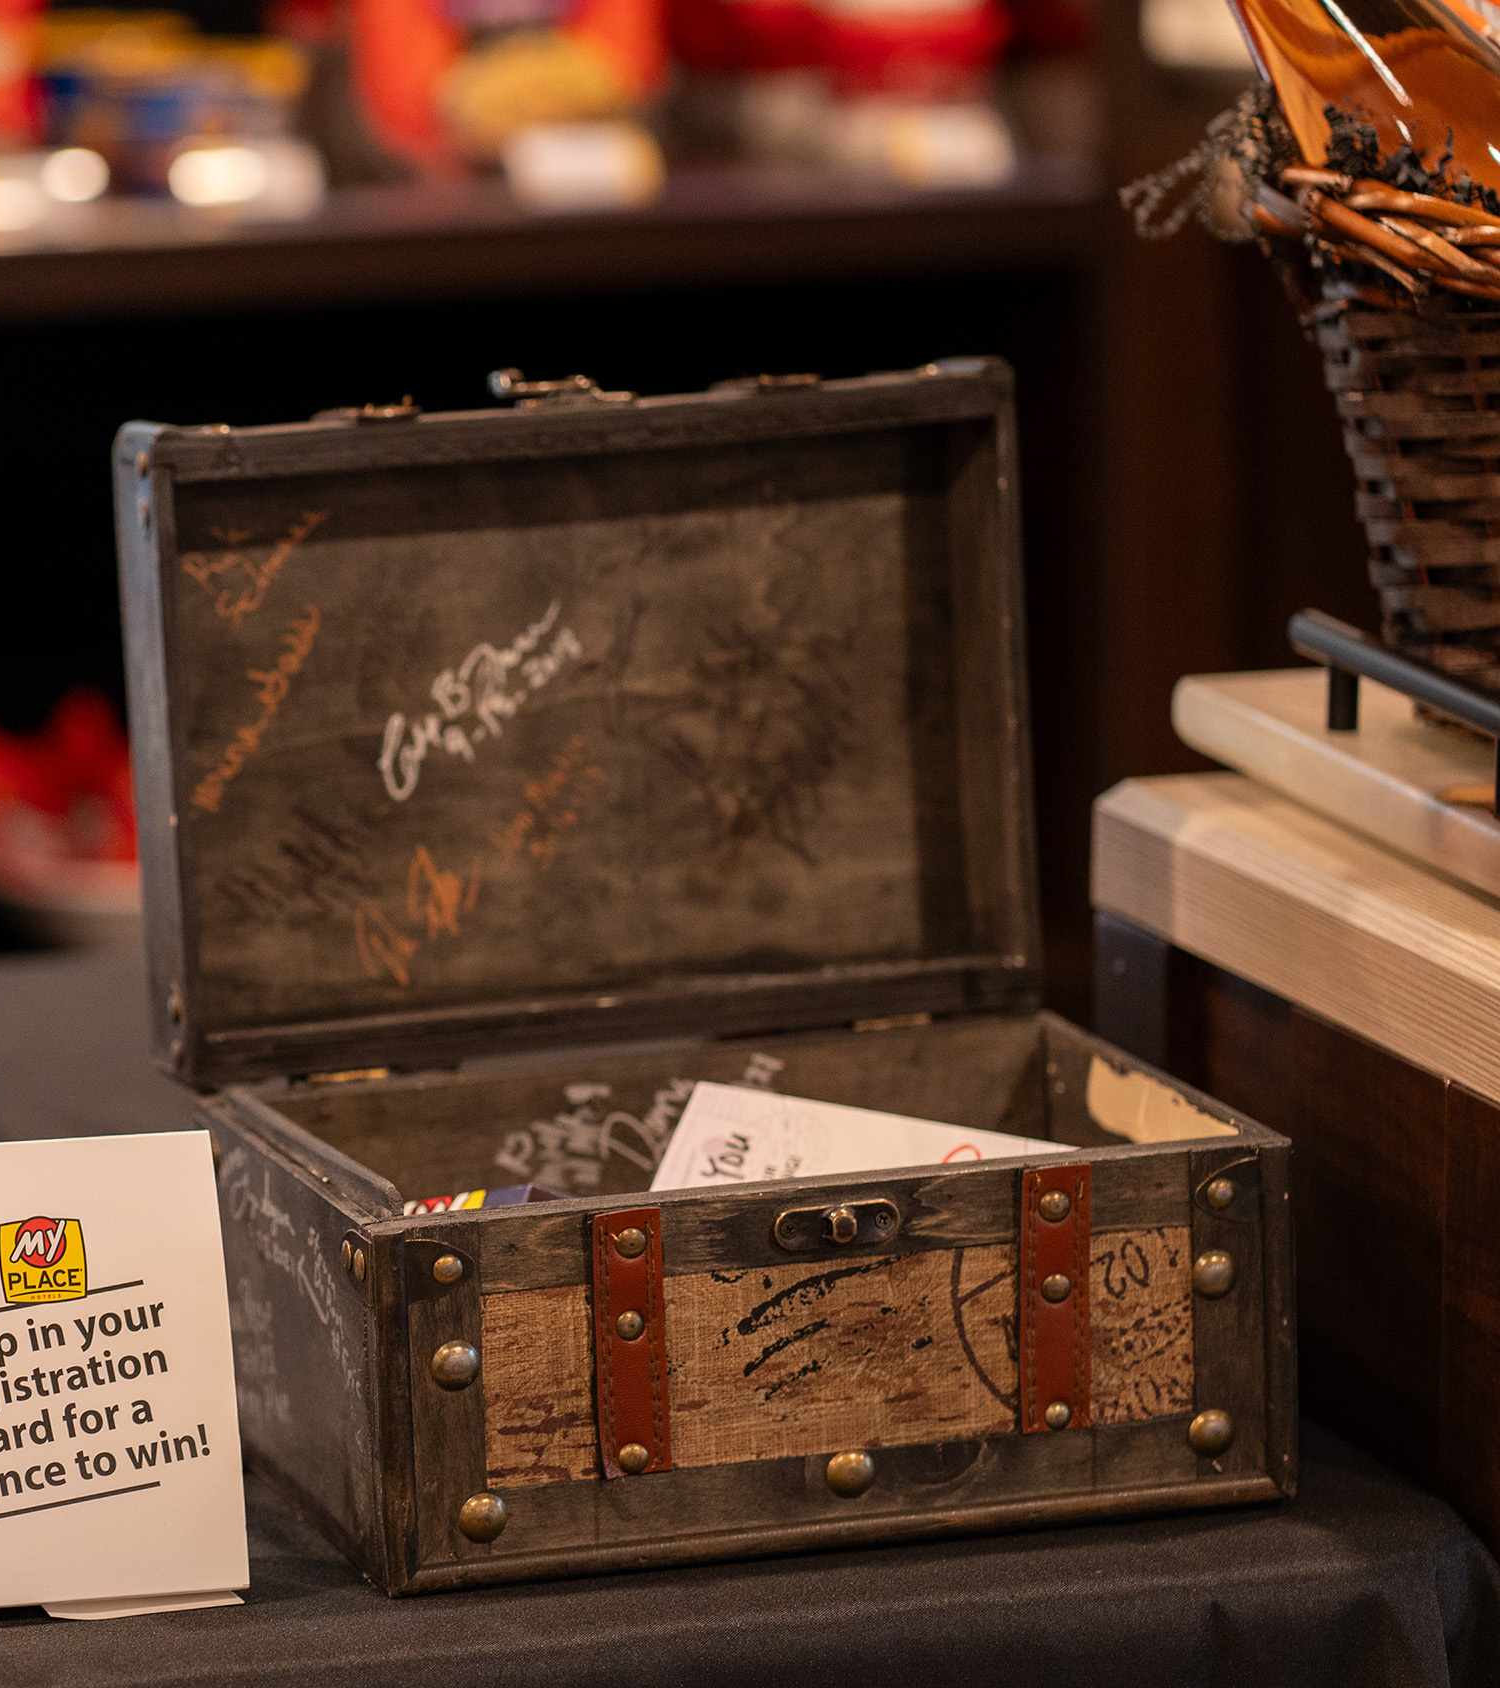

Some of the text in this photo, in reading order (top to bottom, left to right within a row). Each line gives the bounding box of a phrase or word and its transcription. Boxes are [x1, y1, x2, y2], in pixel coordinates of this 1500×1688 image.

[7, 1268, 82, 1291] PLACE
[26, 1318, 66, 1352] in
[74, 1301, 164, 1353] your
[62, 1402, 120, 1439] for
[130, 1399, 154, 1425] a
[74, 1450, 117, 1480] to
[125, 1423, 212, 1470] win!
